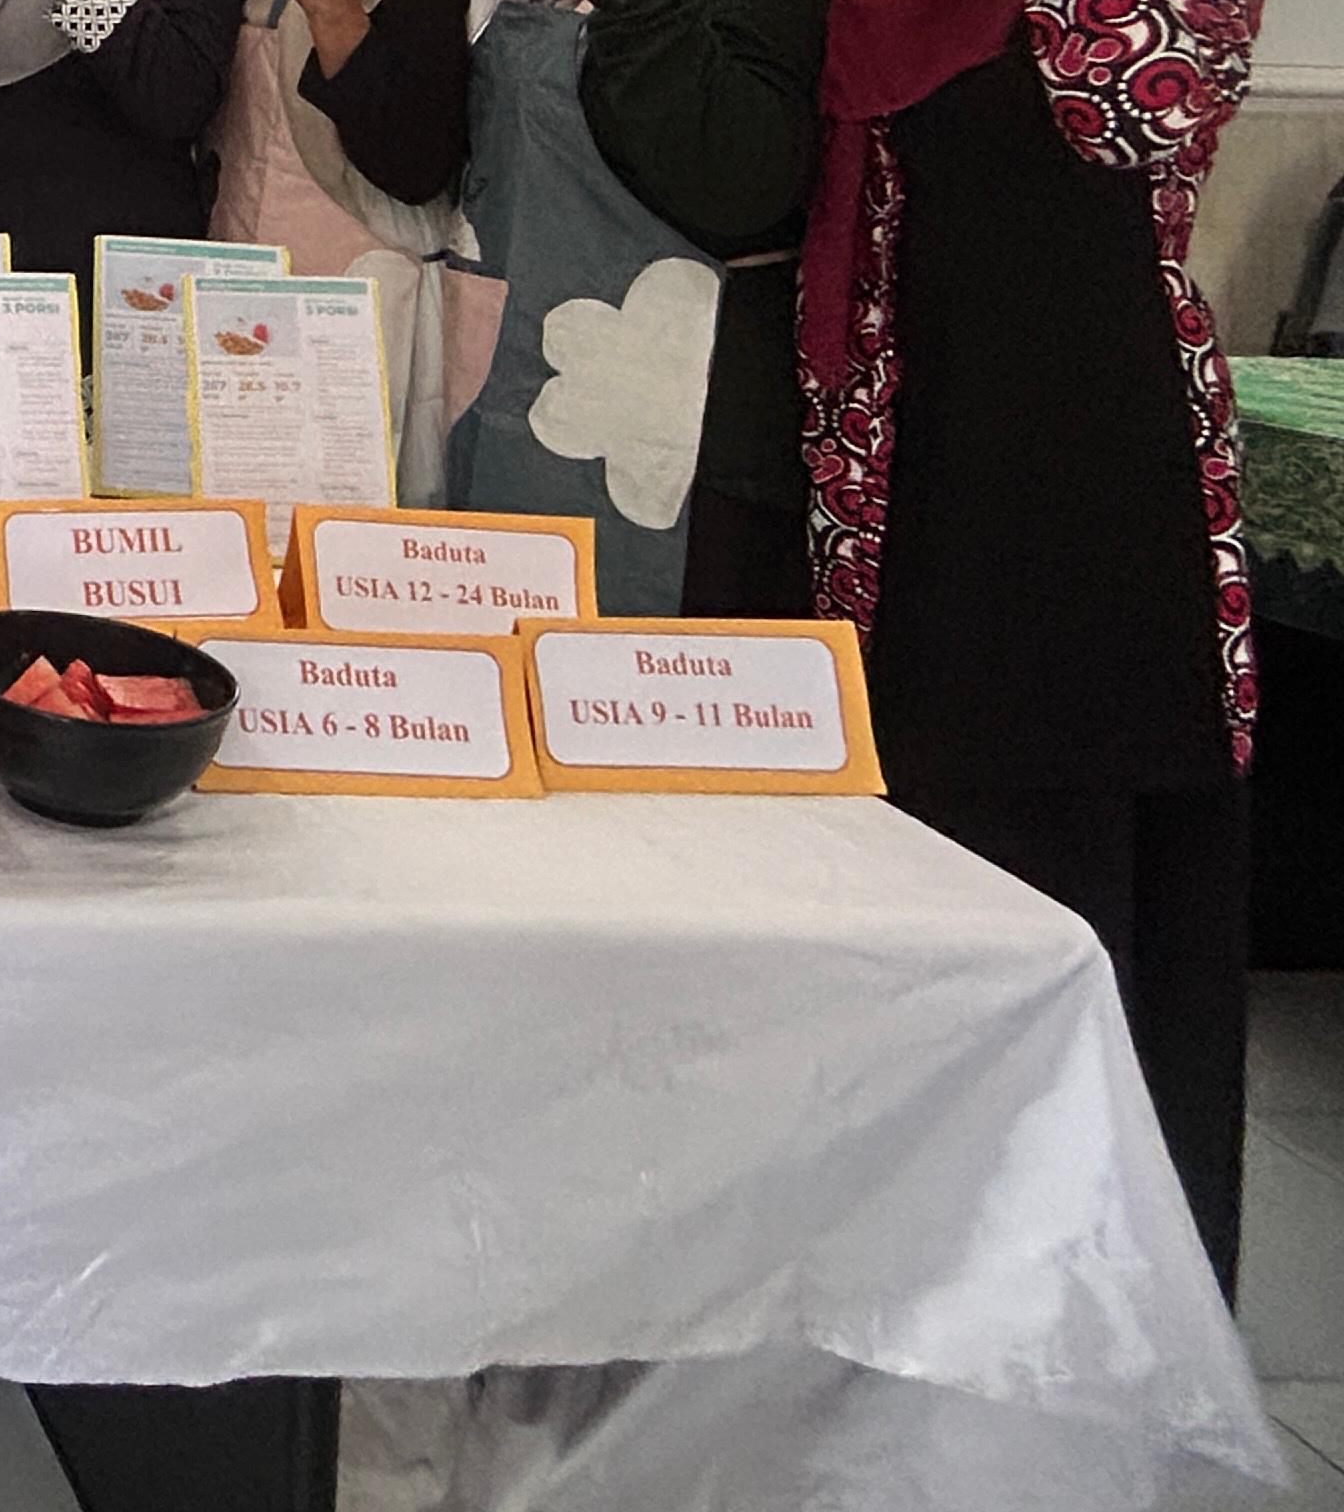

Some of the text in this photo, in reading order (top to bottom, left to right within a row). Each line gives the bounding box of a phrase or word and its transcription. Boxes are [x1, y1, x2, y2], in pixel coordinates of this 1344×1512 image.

[15, 303, 60, 314] PORSI
[72, 527, 183, 554] BUMIL
[402, 538, 487, 564] Baduta
[82, 579, 182, 607] BUSUI
[336, 575, 400, 601] USIA
[407, 581, 433, 602] 12
[457, 584, 483, 605] 24
[490, 586, 559, 611] Bulan
[299, 659, 398, 688] Baduta
[635, 650, 732, 677] Baduta
[238, 707, 313, 735] USIA
[321, 712, 339, 737] 6
[363, 713, 381, 738] 8
[388, 714, 470, 743] Bulan
[570, 699, 644, 725] USIA
[651, 701, 667, 725] 9
[696, 702, 722, 727] 11
[733, 702, 813, 729] Bulan
